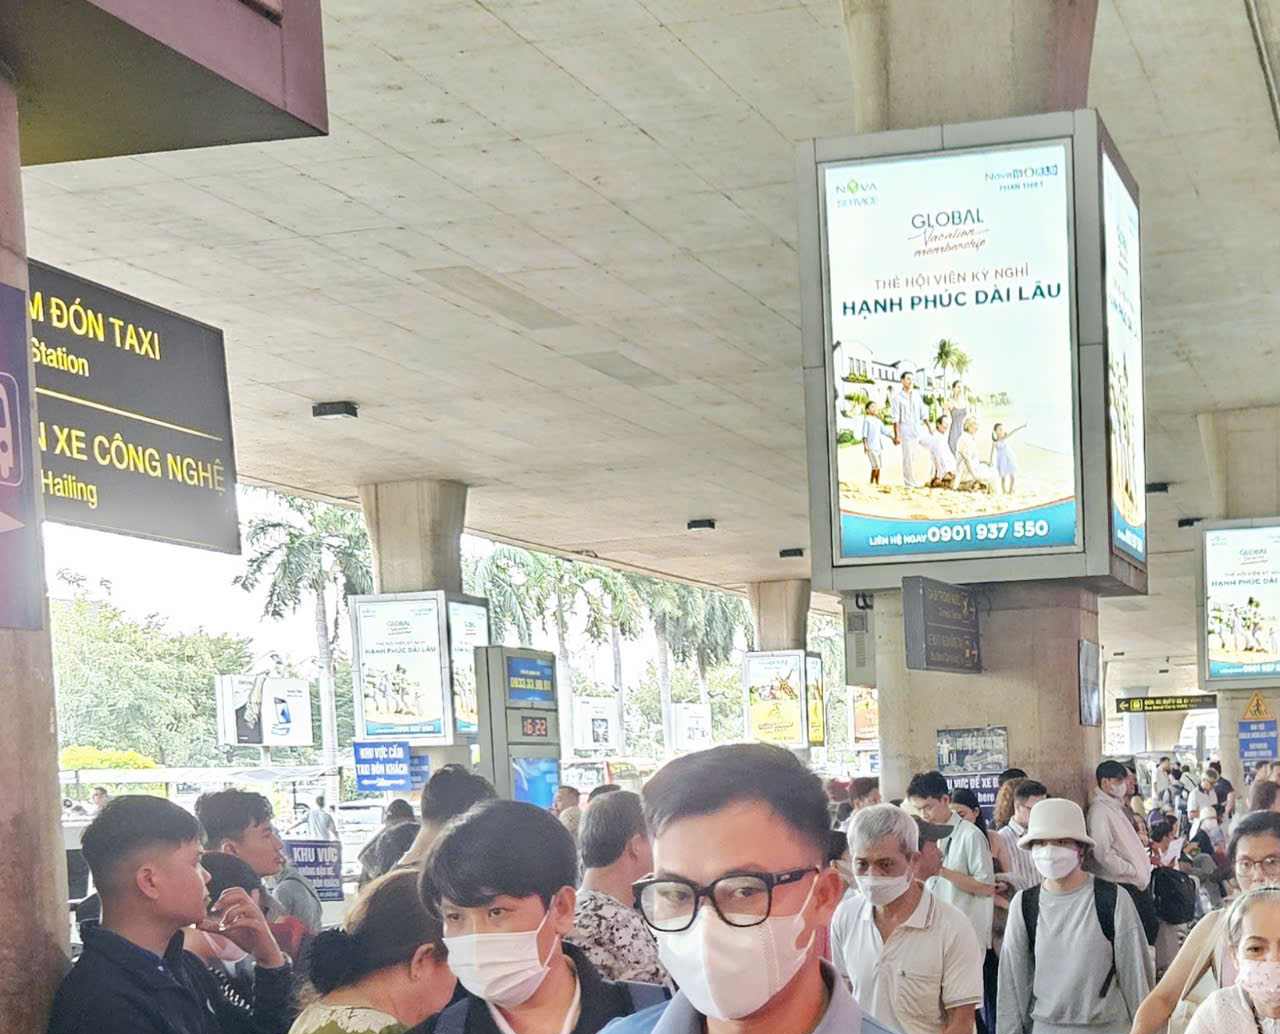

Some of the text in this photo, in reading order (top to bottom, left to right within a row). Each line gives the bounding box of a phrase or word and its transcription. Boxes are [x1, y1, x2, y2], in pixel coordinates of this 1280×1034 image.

[911, 207, 984, 229] GLOBAL
[842, 279, 1062, 320] HẠNH PHÚC DÀI LÂU
[50, 297, 105, 342] ĐÓN
[108, 316, 161, 361] TAXI
[31, 335, 90, 378] Station
[53, 424, 88, 461] XE
[93, 432, 162, 479] CÔNG
[41, 469, 98, 509] Hailing
[903, 534, 928, 545] NGAY
[927, 524, 972, 543] 0901
[976, 522, 1008, 540] 937
[1013, 519, 1049, 538] 550
[981, 777, 993, 789] XE
[293, 846, 338, 865] KHU VỰC
